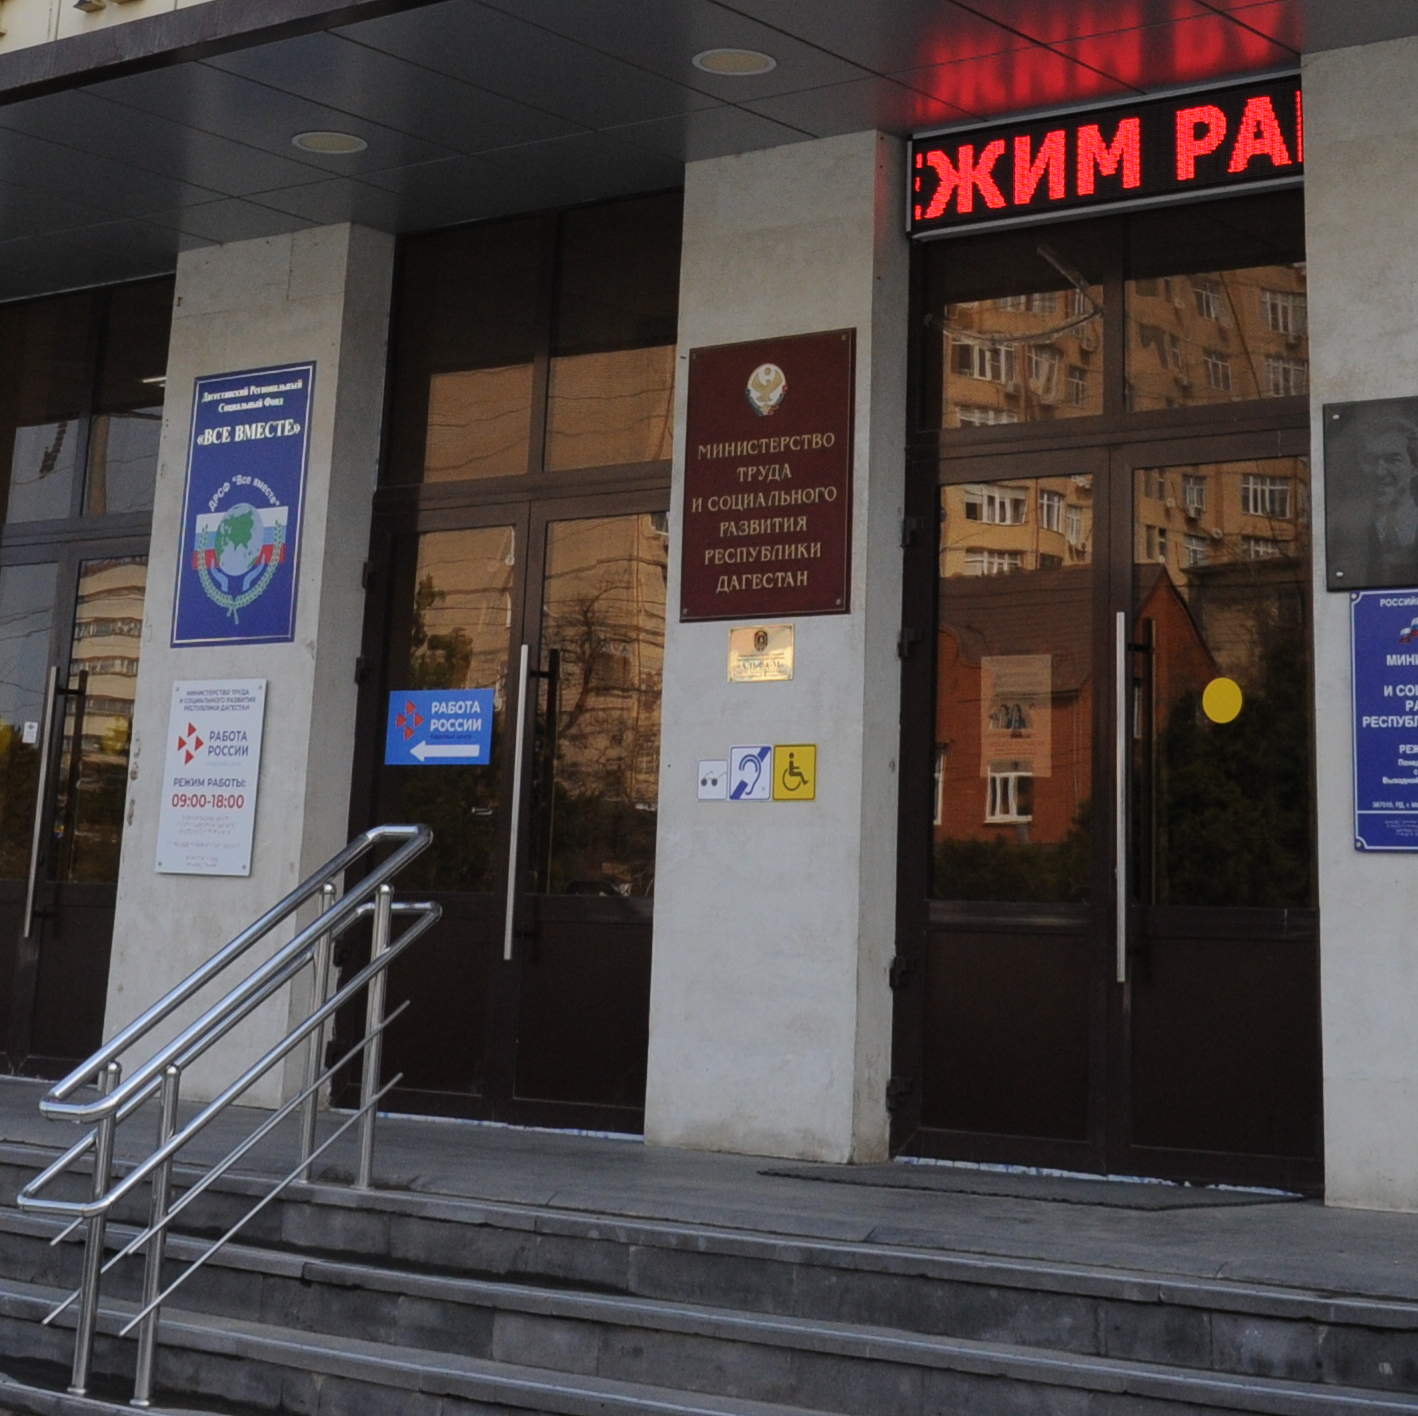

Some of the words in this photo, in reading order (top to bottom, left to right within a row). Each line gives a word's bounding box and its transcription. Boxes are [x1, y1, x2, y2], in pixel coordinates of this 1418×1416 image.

[915, 117, 1141, 220] ЖИМ
[1175, 90, 1303, 181] РА
[197, 426, 231, 445] «ВСЕ
[234, 419, 301, 442] ВМЕСТЕ»
[698, 432, 835, 460] МИНИСТЕРСТВО
[737, 463, 792, 483] ТРУДА
[692, 497, 703, 513] И
[708, 486, 837, 512] СОЦИАЛЬНОГО
[719, 516, 807, 537] РАЗВИТИЯ
[704, 542, 822, 565] РЕСПУБЛИКИ
[716, 570, 809, 594] ДАГЕСТАН
[1384, 685, 1393, 697] И
[431, 701, 481, 714] РАБОТА
[430, 718, 482, 732] РОССИИ
[209, 731, 248, 742] РАБОТА
[207, 745, 249, 756] РОССИИ
[173, 777, 205, 787] РЕЖИМ
[207, 778, 247, 788] РАБОТЫ:
[171, 793, 245, 809] 09:00-18:00
